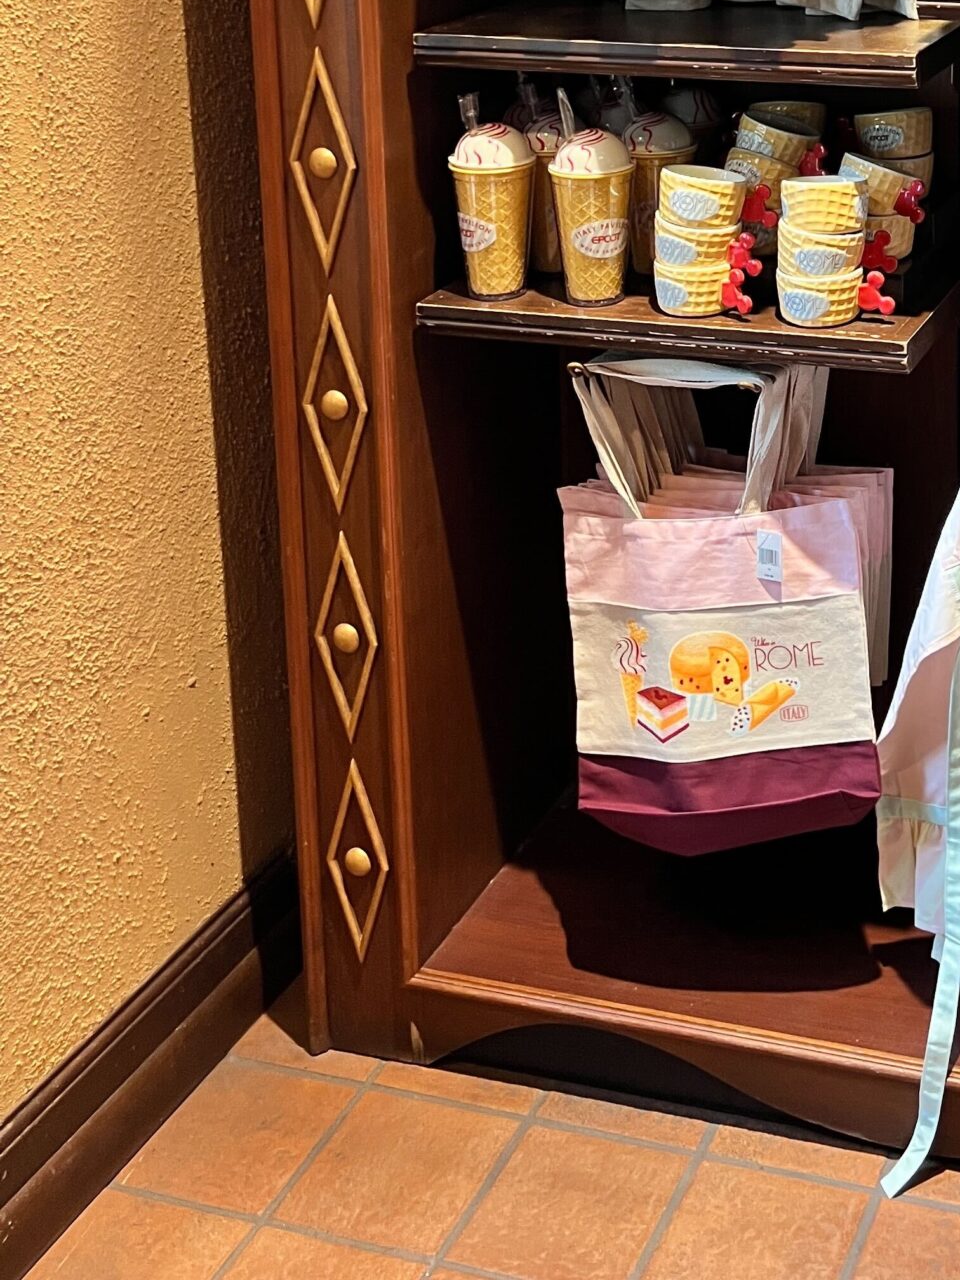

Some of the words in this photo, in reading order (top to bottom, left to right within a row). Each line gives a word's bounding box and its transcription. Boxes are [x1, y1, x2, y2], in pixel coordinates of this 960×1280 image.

[591, 232, 621, 244] EPCOT
[754, 640, 824, 672] ROME
[782, 705, 807, 721] ITALY
